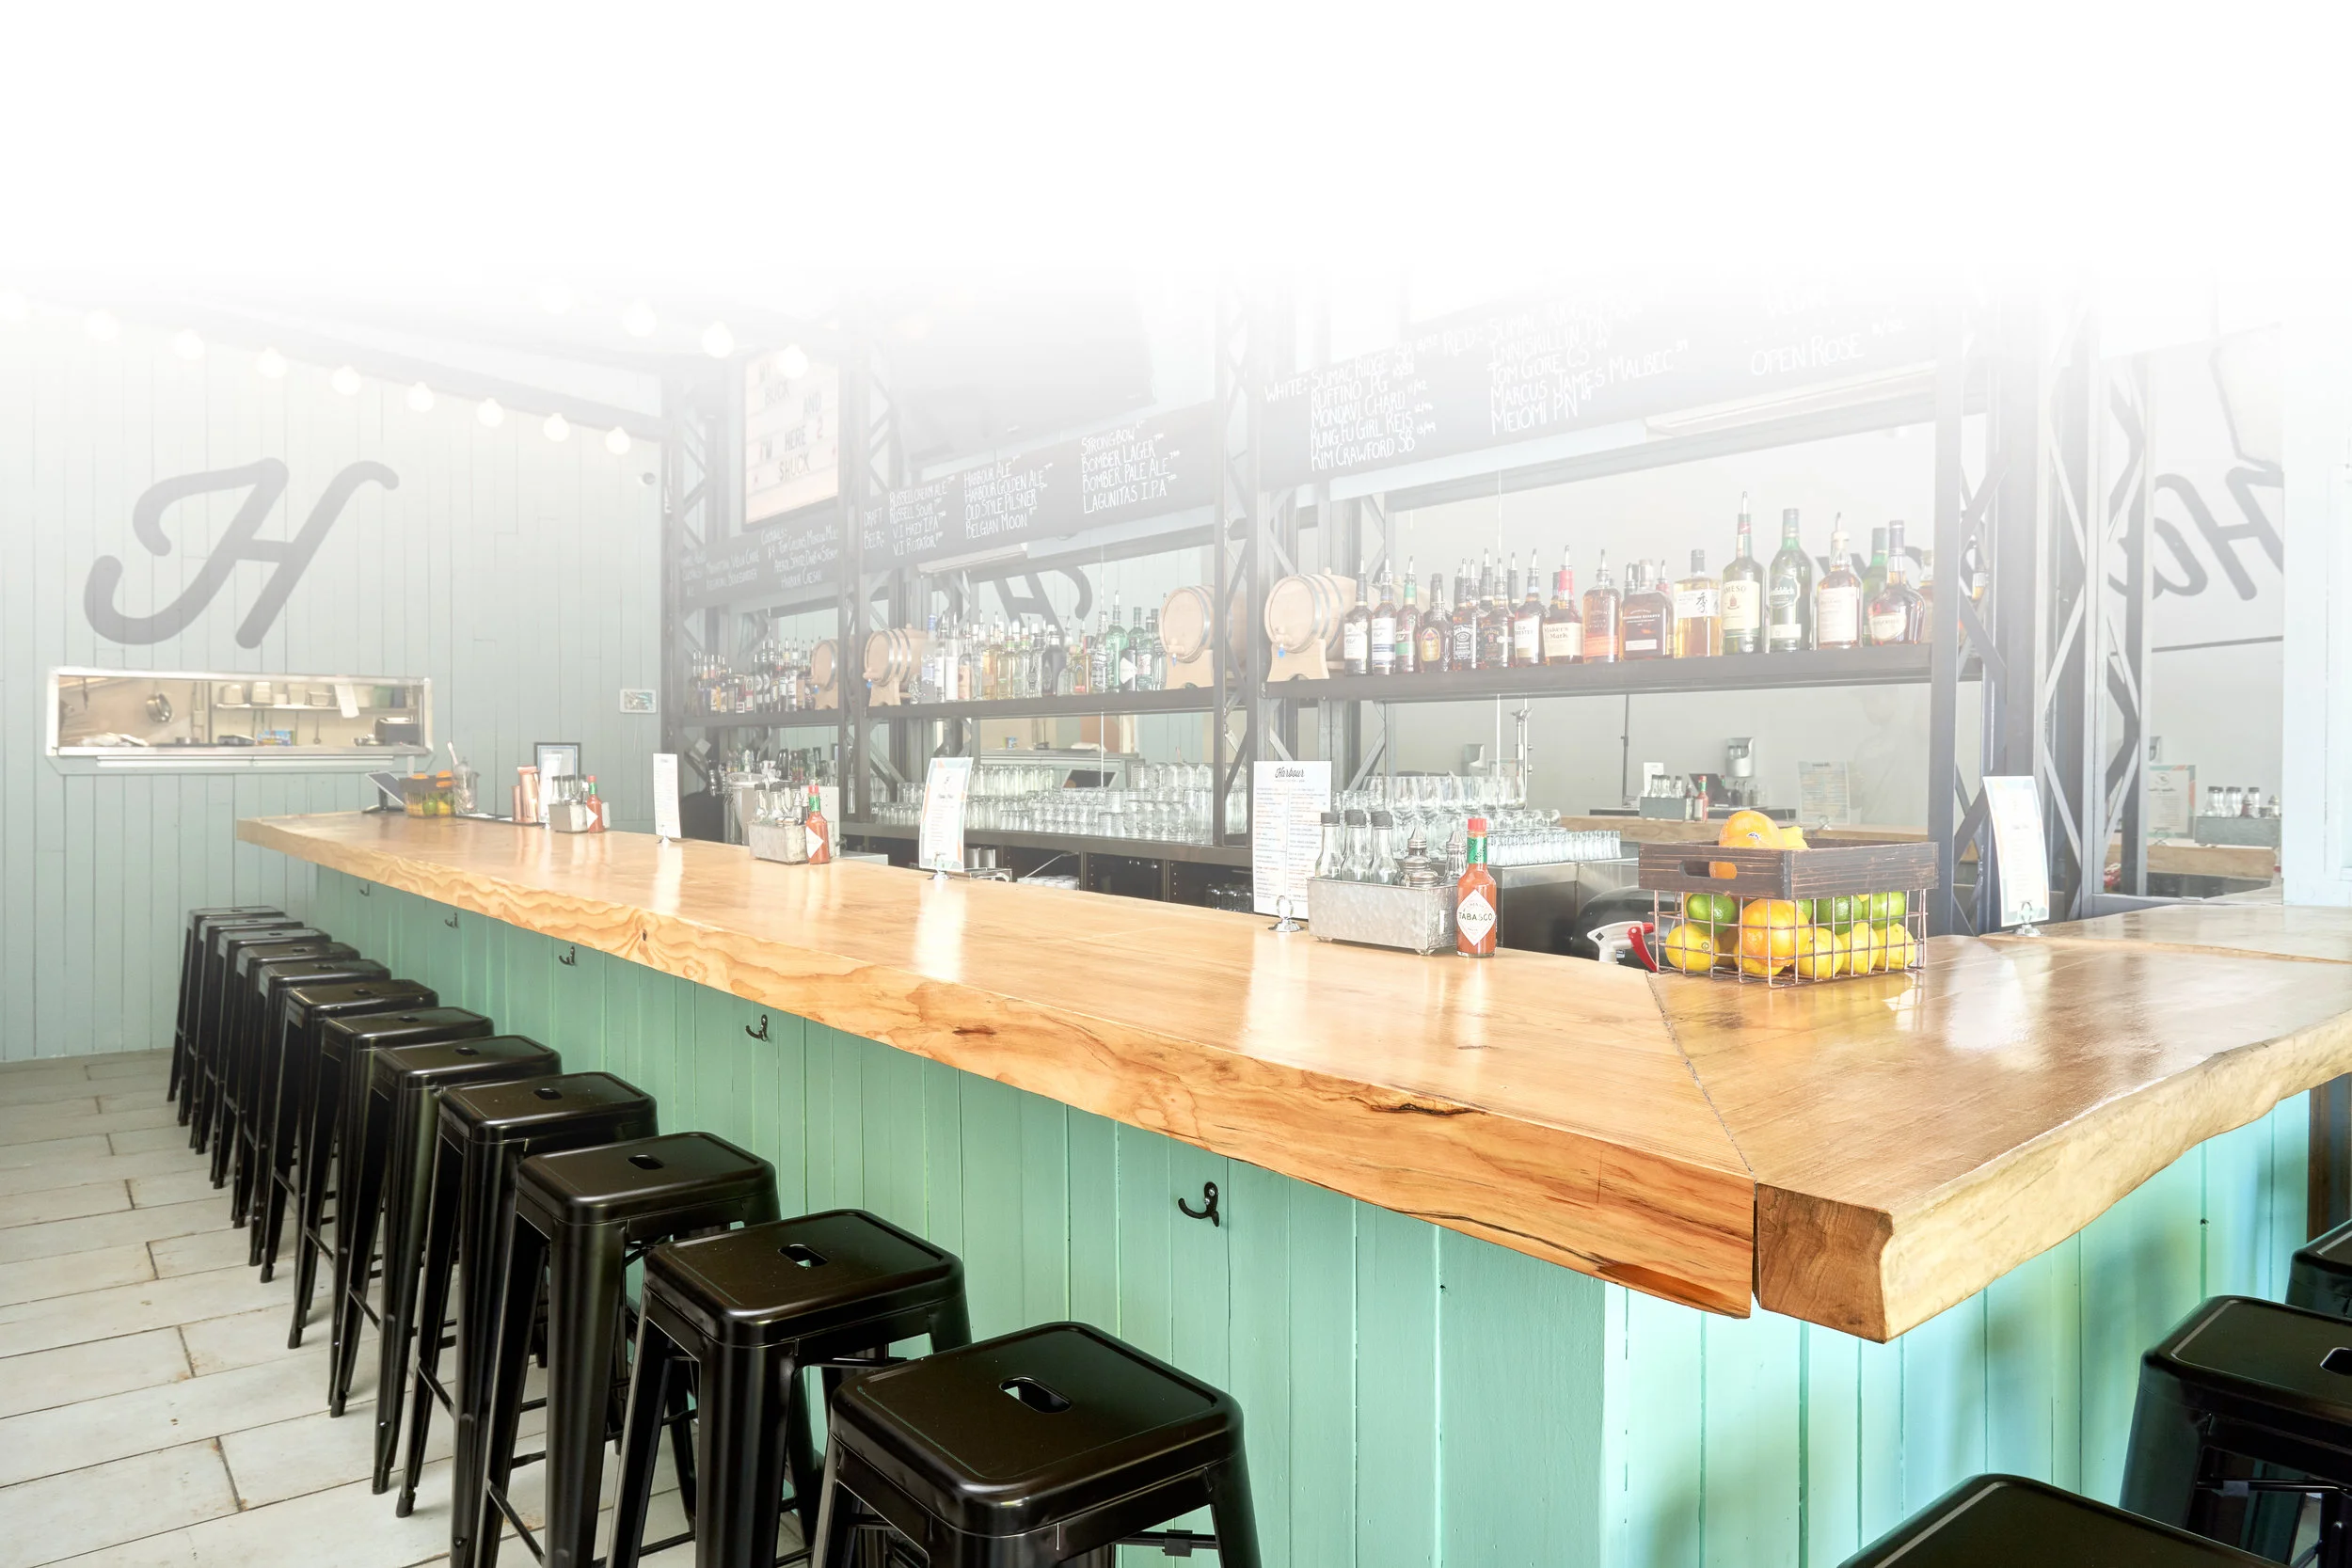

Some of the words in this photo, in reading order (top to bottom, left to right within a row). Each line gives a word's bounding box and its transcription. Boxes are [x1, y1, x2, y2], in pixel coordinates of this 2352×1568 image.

[1810, 333, 1865, 368] ROSE
[1486, 361, 1518, 387] TOM
[1521, 353, 1564, 379] GORE
[1490, 380, 1548, 411] MARCUS
[1552, 367, 1606, 395] JAMES
[1609, 349, 1675, 384] MALBEC
[1264, 377, 1309, 403] WHITE:
[1311, 380, 1361, 410] RUFFINO
[1311, 404, 1361, 429] MONDAVI
[1364, 390, 1406, 417] CHARD
[1490, 404, 1548, 436] MEIOMI
[784, 424, 807, 452] HERE
[1356, 417, 1385, 439] GIRL
[779, 449, 811, 483] SHUCK
[1081, 450, 1120, 474] BOMBER
[1122, 440, 1156, 463] LAGER
[1311, 448, 1335, 471] KIM
[1336, 436, 1394, 467] CRAWFORD
[1082, 470, 1123, 494] BOMBER
[1124, 462, 1147, 483] PALE
[1149, 457, 1171, 479] ALE
[1083, 484, 1138, 515] LAGUNITAS
[1001, 514, 1027, 531] MOON
[84, 457, 400, 649] H
[1275, 767, 1305, 779] Harbour
[1458, 911, 1493, 922] TABASCO
